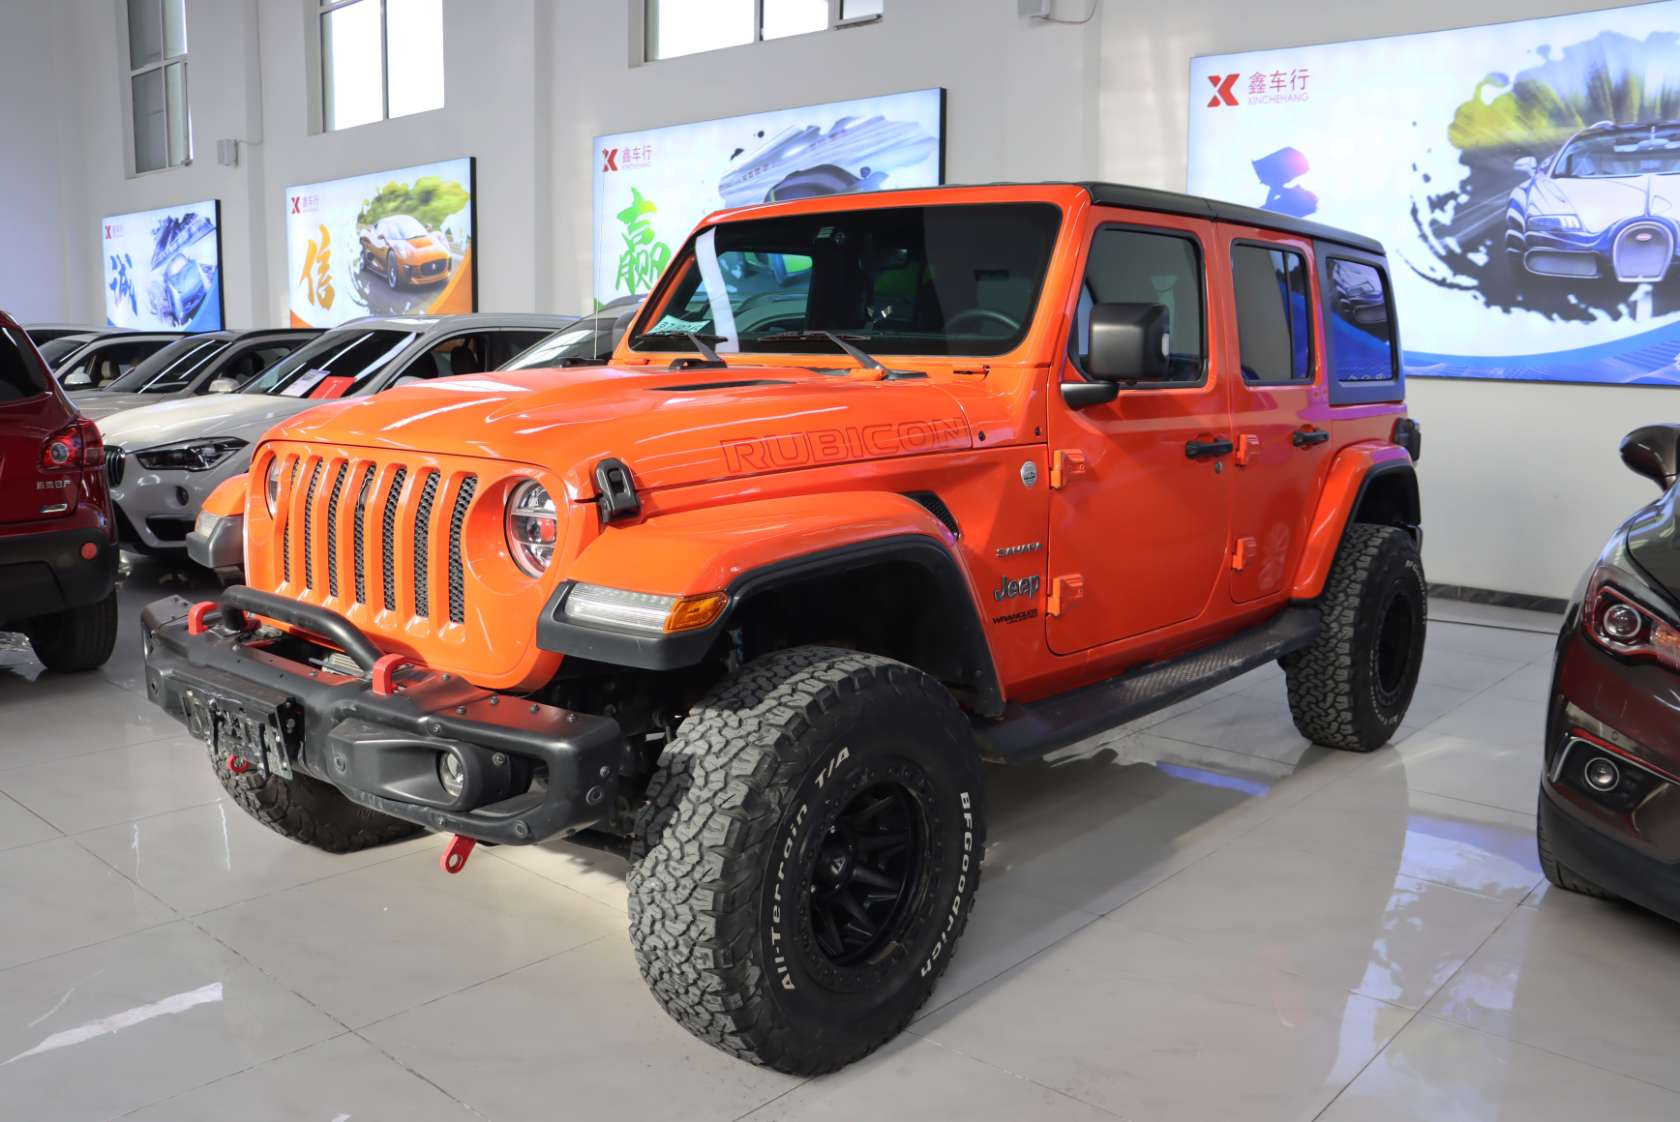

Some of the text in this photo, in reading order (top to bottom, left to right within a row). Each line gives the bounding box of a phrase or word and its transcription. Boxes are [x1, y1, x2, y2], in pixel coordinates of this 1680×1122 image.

[1248, 69, 1309, 94] 鑫车行
[299, 224, 335, 310] 信
[720, 417, 967, 473] RUBICON
[994, 576, 1040, 601] Jeep
[771, 747, 850, 989] All-Terrain T/A
[920, 791, 973, 977] BFGoodrich
